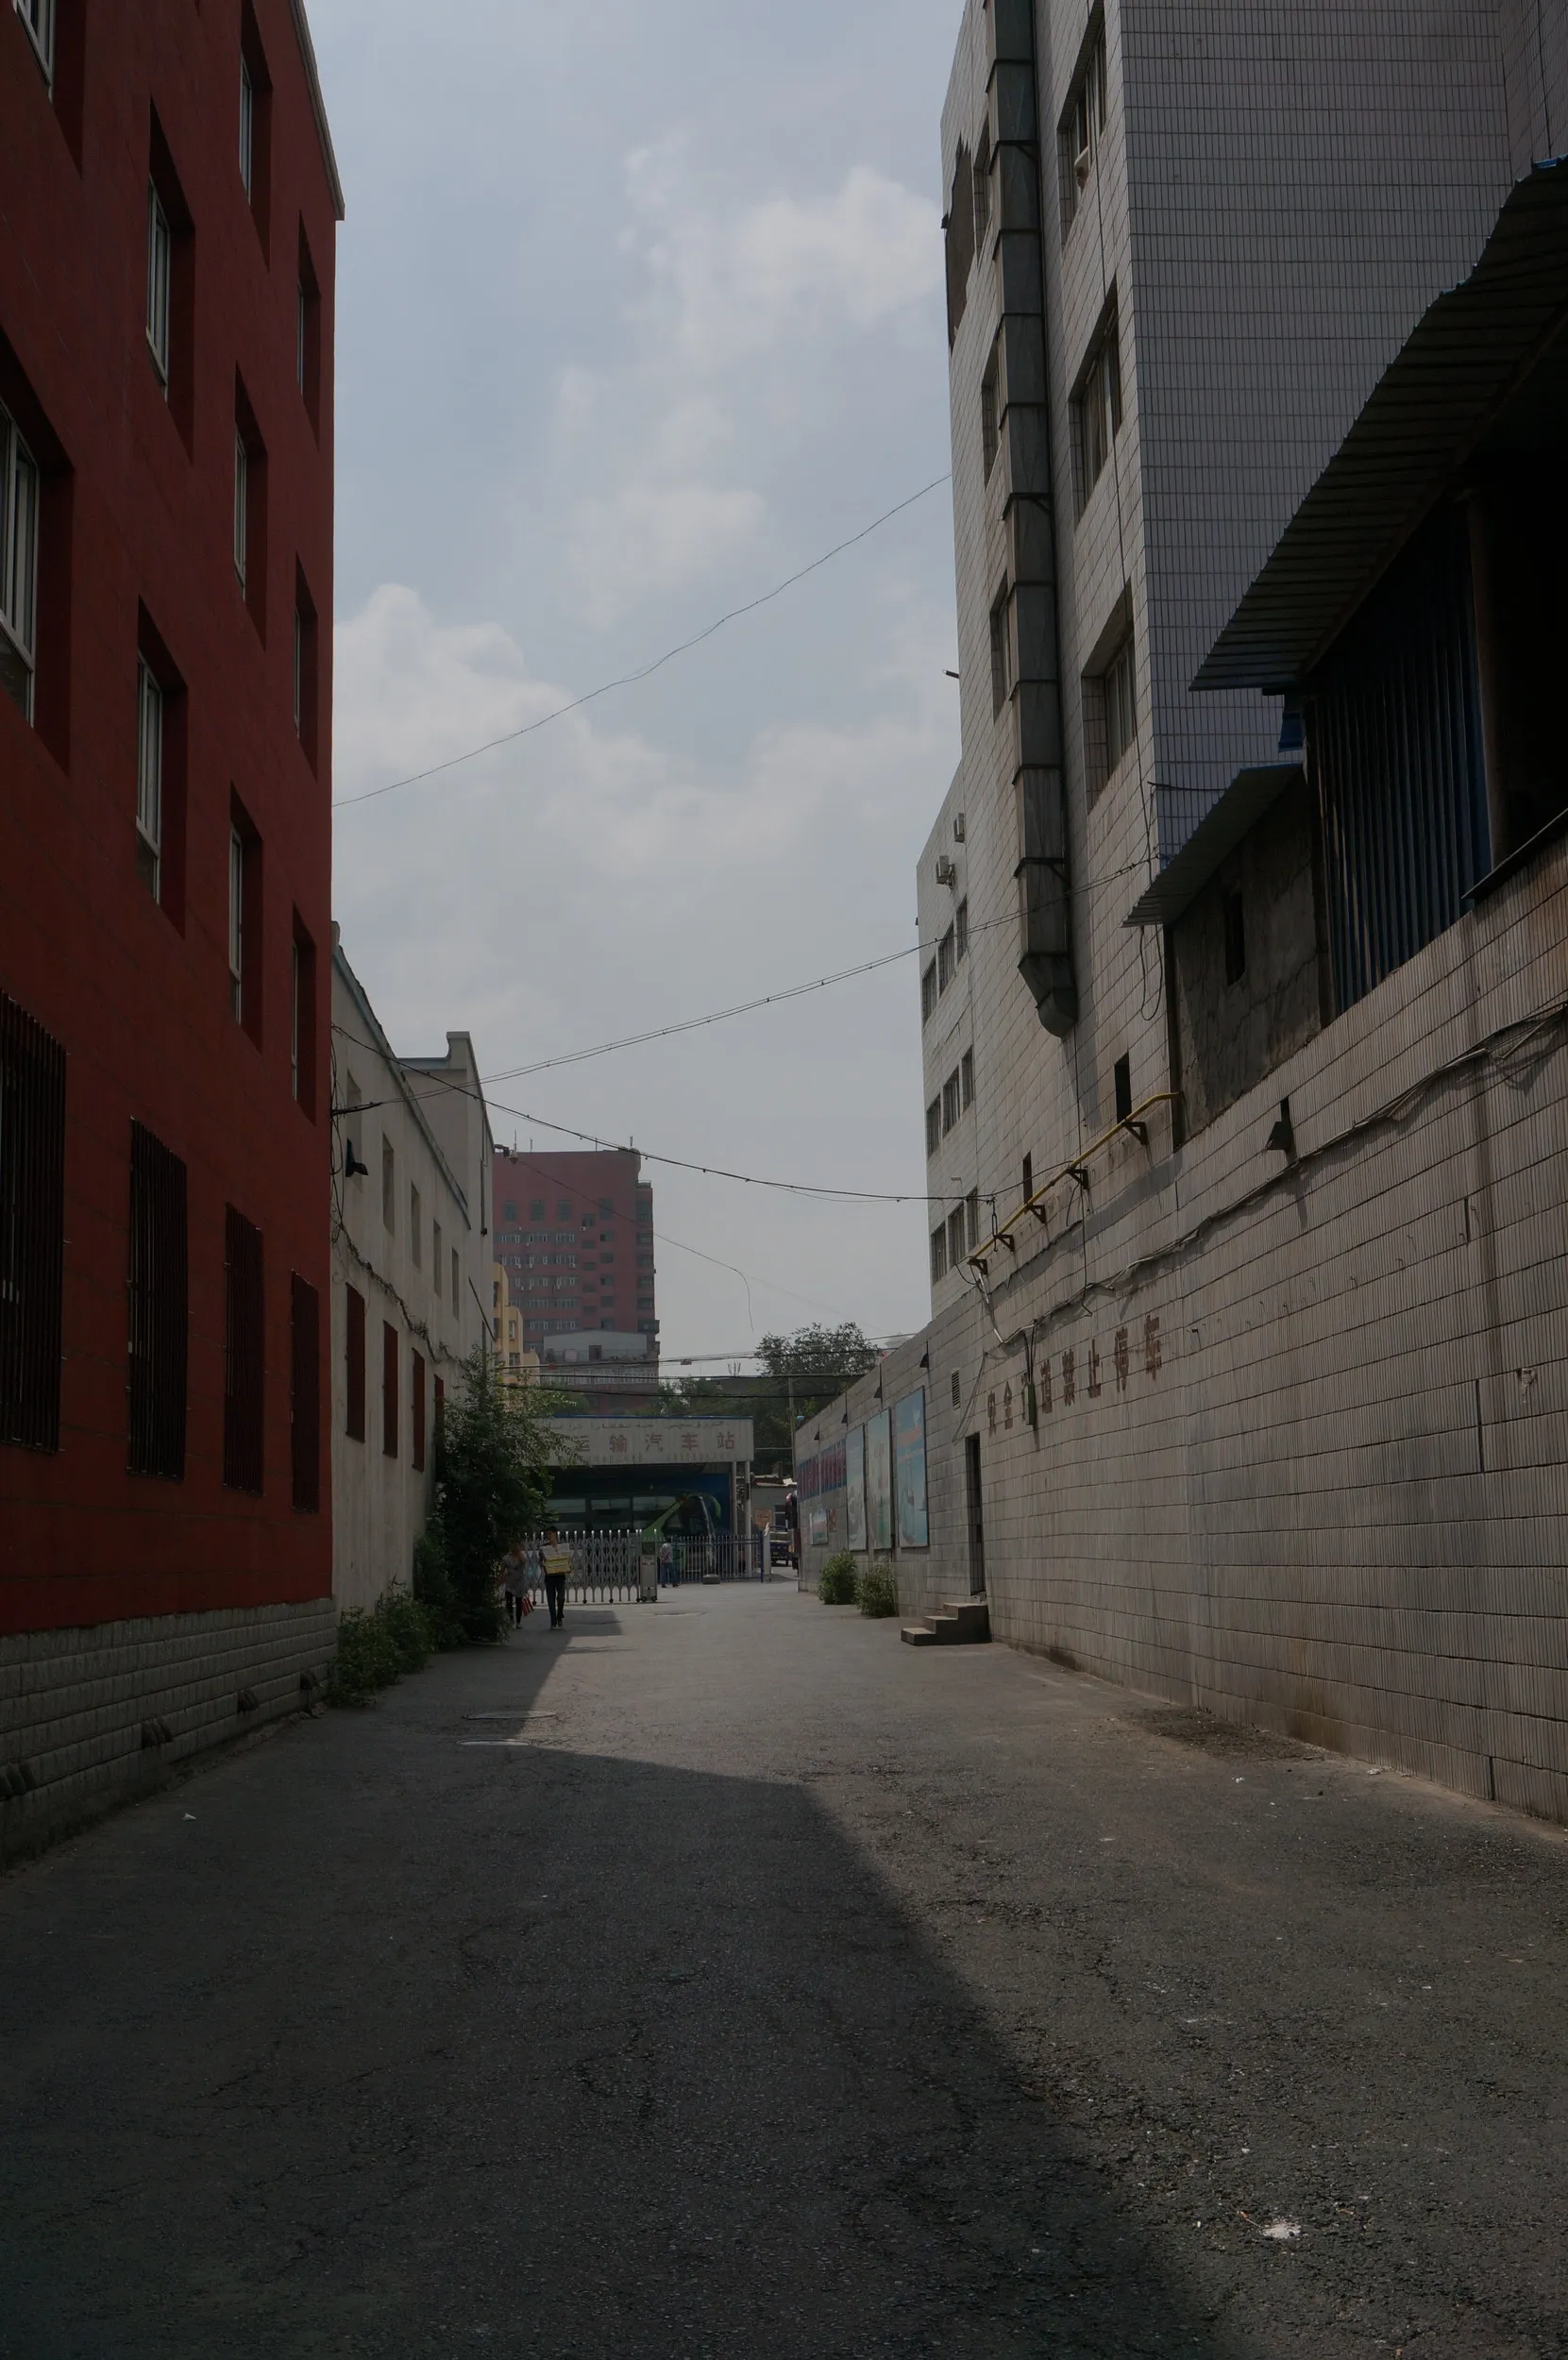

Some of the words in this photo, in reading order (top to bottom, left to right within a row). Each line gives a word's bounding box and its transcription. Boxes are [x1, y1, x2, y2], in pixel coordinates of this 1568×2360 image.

[986, 1314, 1162, 1437] 安全道禁止停车
